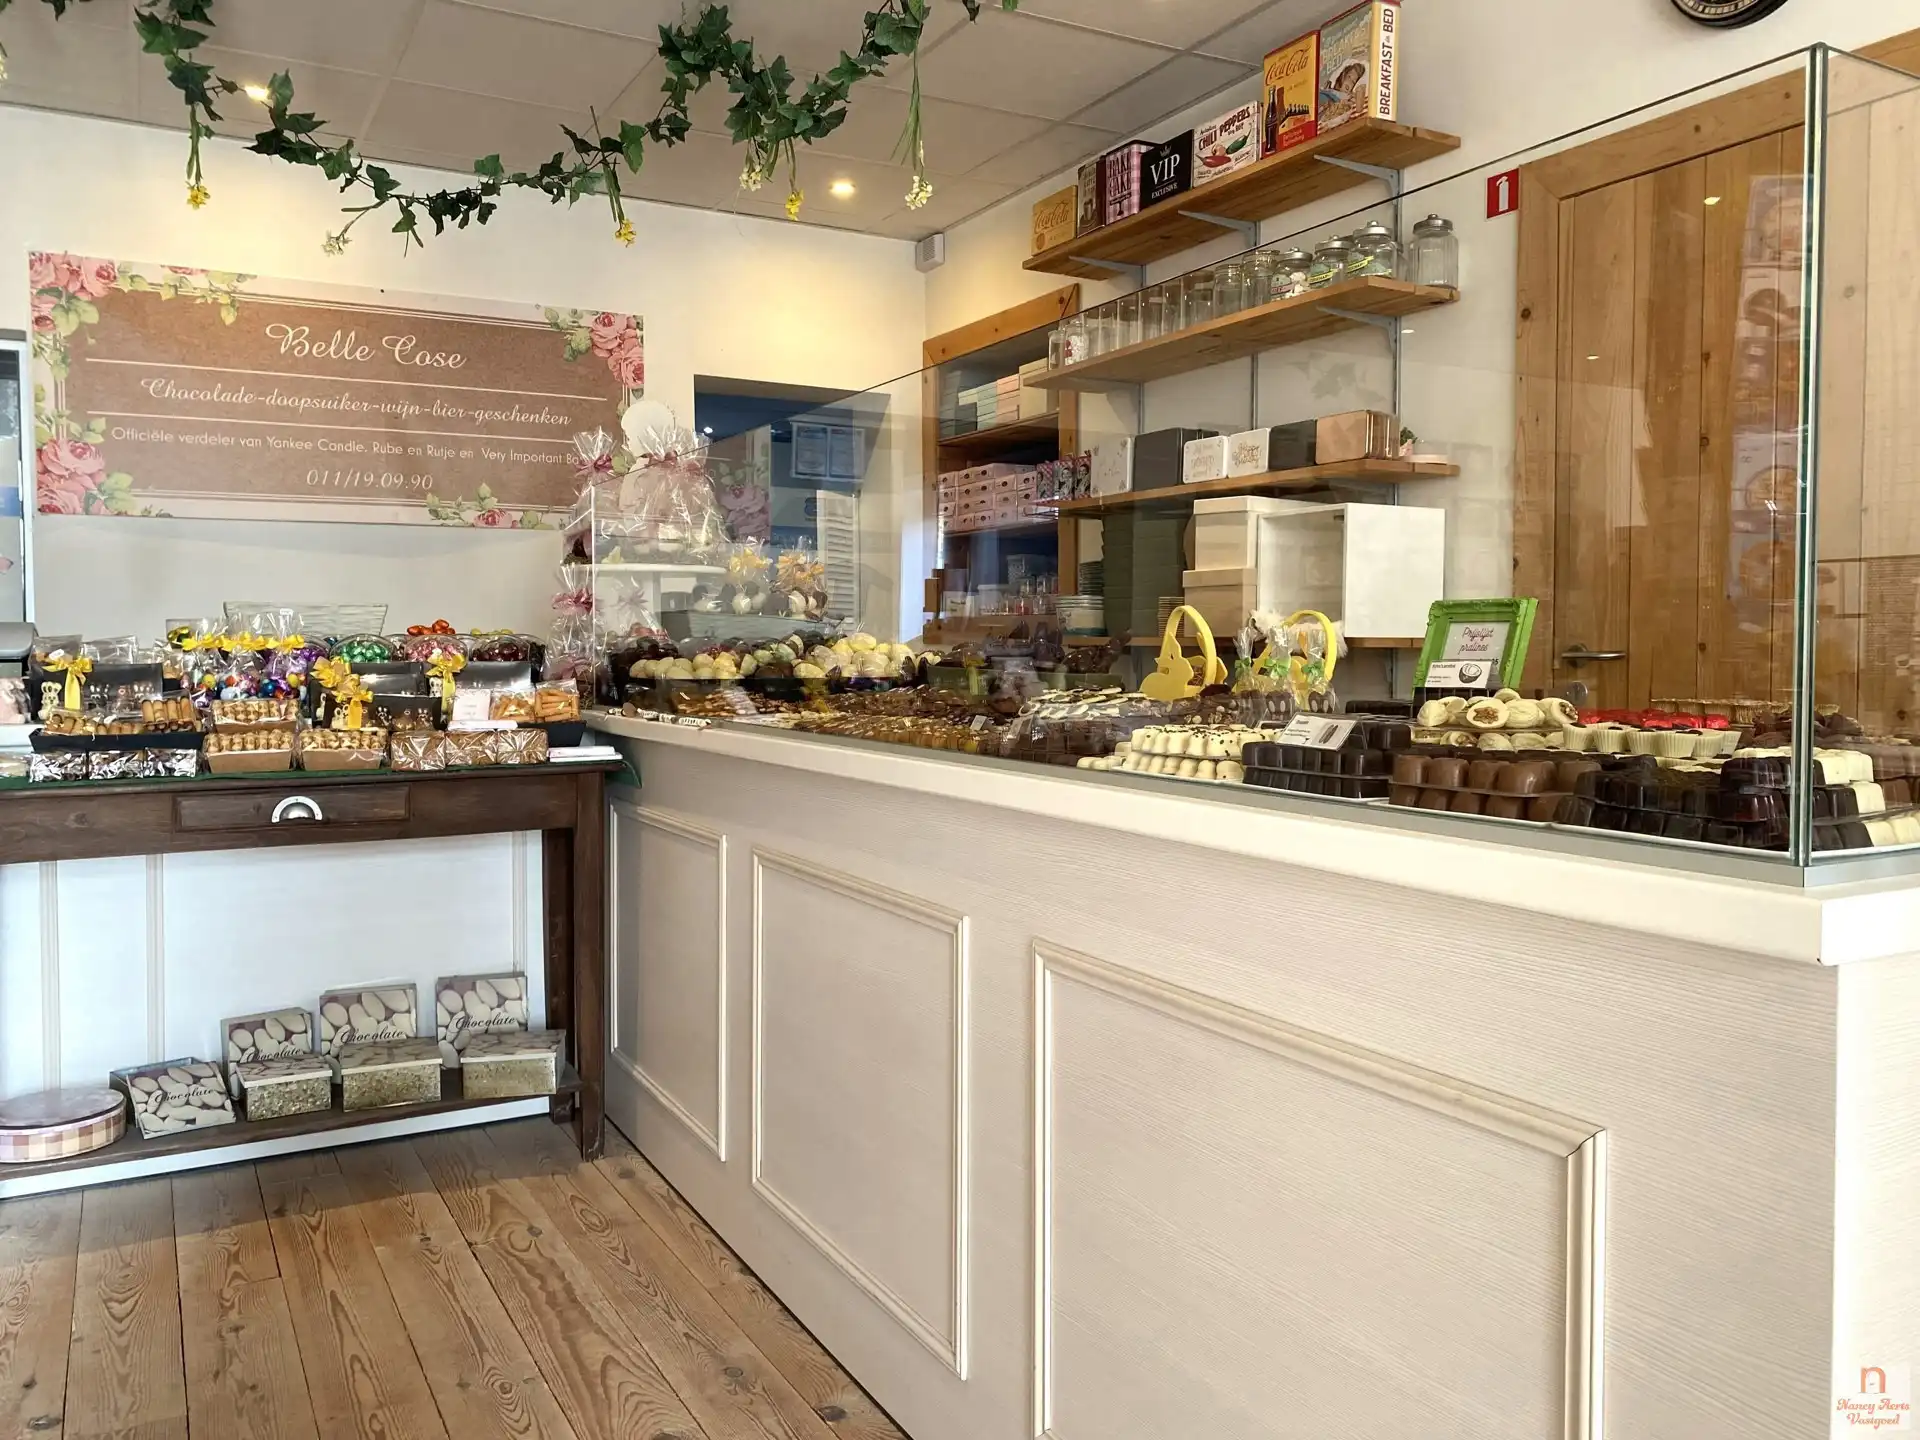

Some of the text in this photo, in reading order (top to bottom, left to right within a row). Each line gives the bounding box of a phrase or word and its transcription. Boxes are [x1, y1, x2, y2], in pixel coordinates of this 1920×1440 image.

[1383, 8, 1394, 33] BED
[1380, 42, 1392, 115] BREAKFAST
[1220, 106, 1251, 136] PEPPERS
[1150, 153, 1180, 185] VIP
[1151, 182, 1178, 199] EXCLUSIVE
[265, 323, 467, 369] Belle Cose
[111, 426, 174, 443] Officiële
[178, 432, 235, 446] verdeler
[239, 437, 262, 448] van
[266, 436, 313, 450] Yankee
[373, 442, 403, 455] Rube
[407, 447, 422, 455] en
[427, 445, 455, 460] Rutje
[459, 449, 474, 459] en
[481, 449, 506, 463] Very
[510, 450, 562, 465] Important
[306, 468, 433, 491] 011/19.09.90
[455, 1011, 518, 1029] Chocolate
[340, 1027, 404, 1044] Chocolate
[247, 1045, 303, 1063] Chocolate
[154, 1087, 216, 1103] Chocolate
